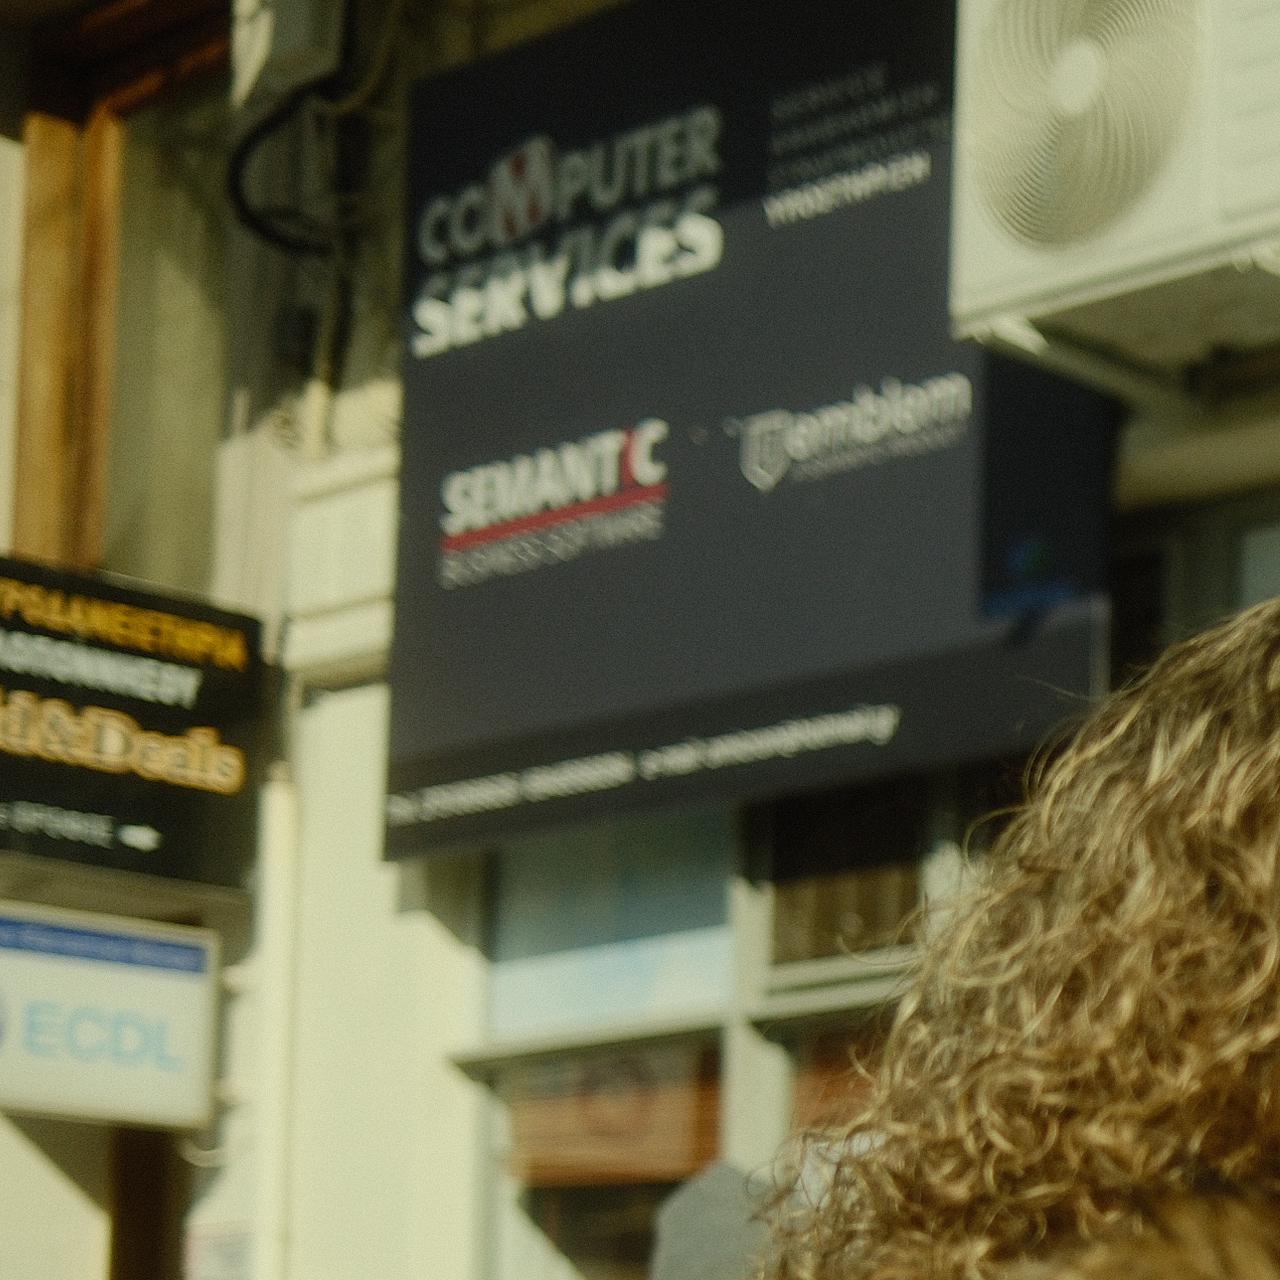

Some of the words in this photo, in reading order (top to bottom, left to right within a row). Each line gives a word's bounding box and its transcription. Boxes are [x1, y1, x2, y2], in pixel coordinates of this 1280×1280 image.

[416, 104, 723, 265] COMPUTER
[411, 185, 724, 358] SERVICES
[22, 999, 187, 1074] ECDL
